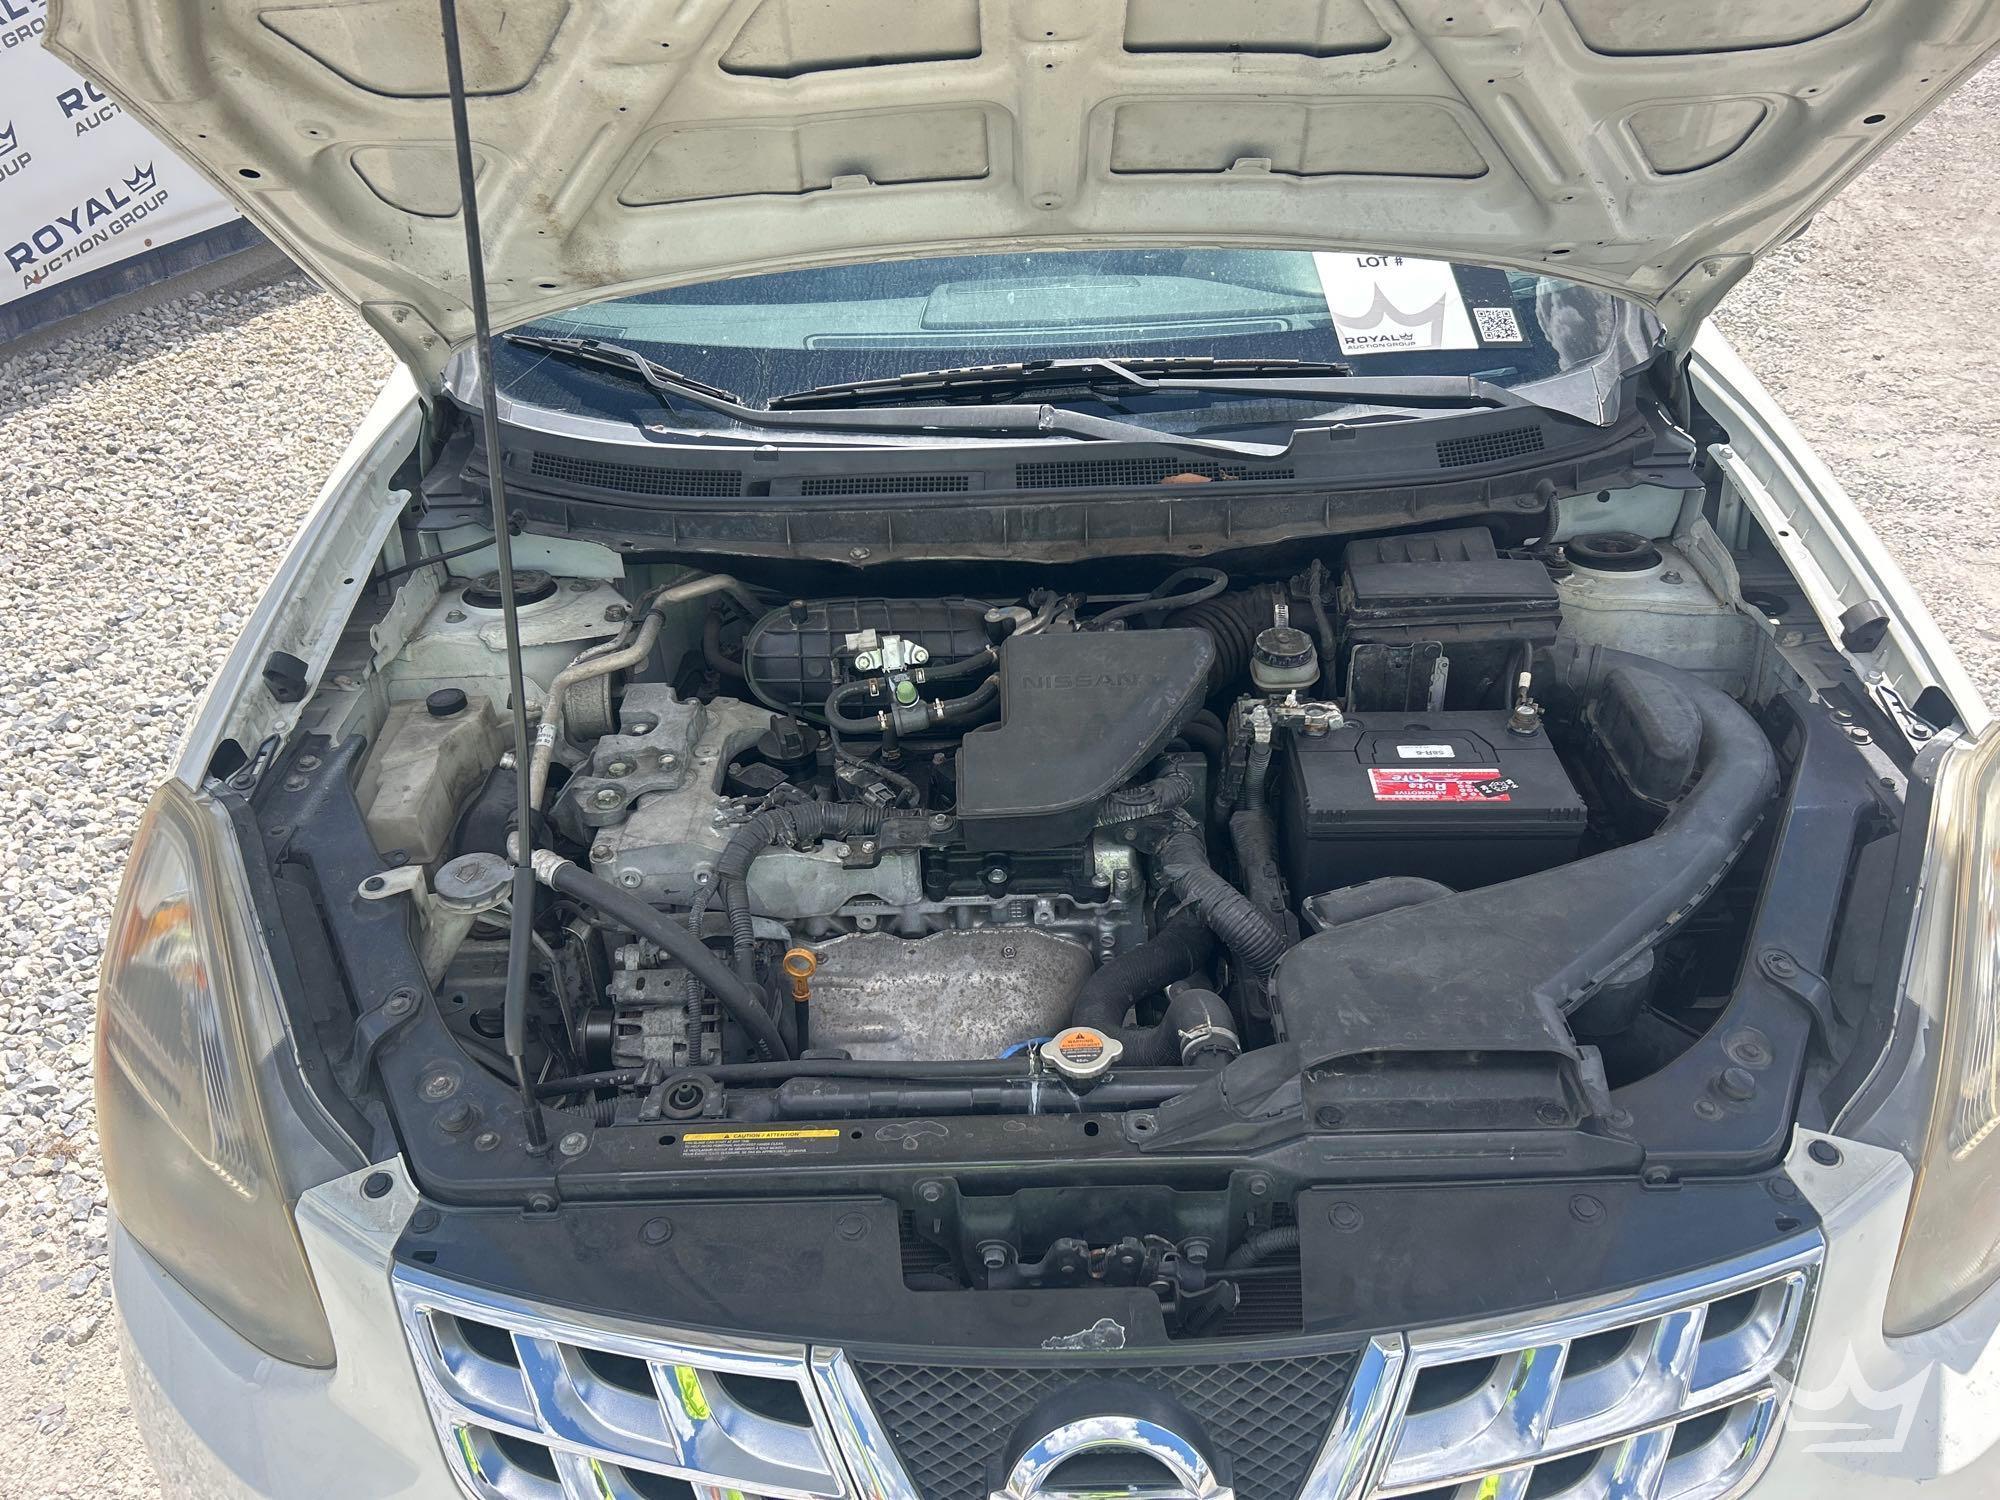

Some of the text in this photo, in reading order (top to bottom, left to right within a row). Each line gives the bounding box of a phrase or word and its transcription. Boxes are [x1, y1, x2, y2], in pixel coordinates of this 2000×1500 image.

[1, 15, 47, 49] GRO
[4, 187, 131, 273] ROYAL
[23, 189, 169, 290] AUCTION GROUP
[1356, 256, 1403, 267] LOT #
[1345, 335, 1400, 344] ROYAL
[1022, 673, 1140, 689] NISSAN
